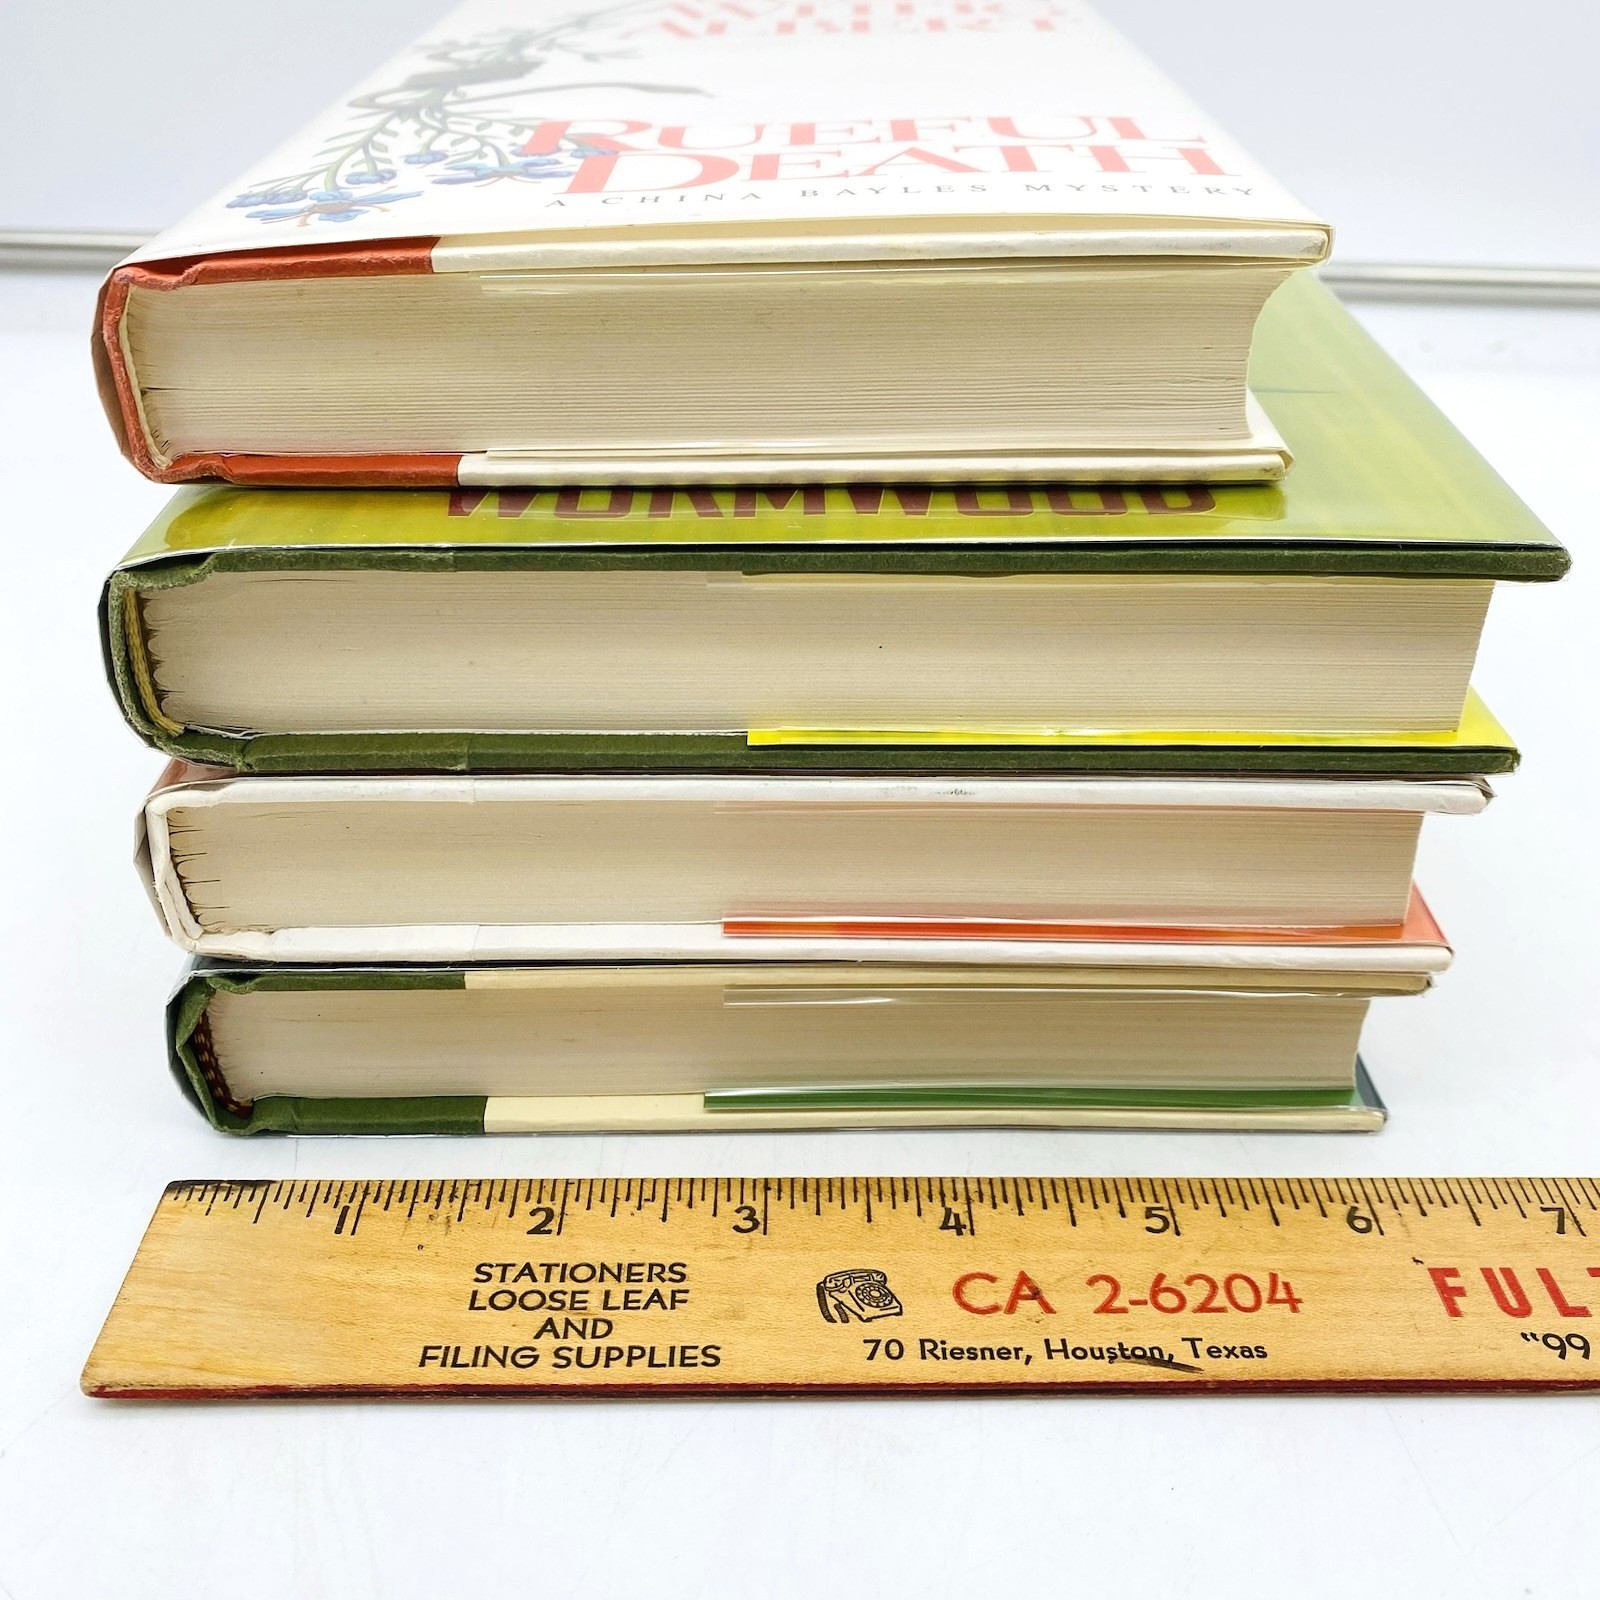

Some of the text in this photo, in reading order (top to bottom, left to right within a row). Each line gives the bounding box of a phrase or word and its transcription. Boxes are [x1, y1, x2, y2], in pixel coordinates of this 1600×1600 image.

[522, 116, 1206, 156] RUEFUL
[552, 144, 1242, 195] DEATH
[602, 193, 762, 205] CHINA
[800, 184, 987, 197] BAYLES
[1025, 184, 1255, 196] MYSTERY
[334, 1205, 1566, 1236] 1 2 3 4 5 6 7
[473, 1261, 687, 1284] STATIONERS
[468, 1288, 690, 1312] LOOSE LEAF
[951, 1269, 1304, 1316] CA 2-6204
[533, 1317, 614, 1340] AND
[418, 1344, 721, 1369] FILING SUPPLIES
[863, 1336, 1269, 1365] 70 Riesner, Houston, Texas
